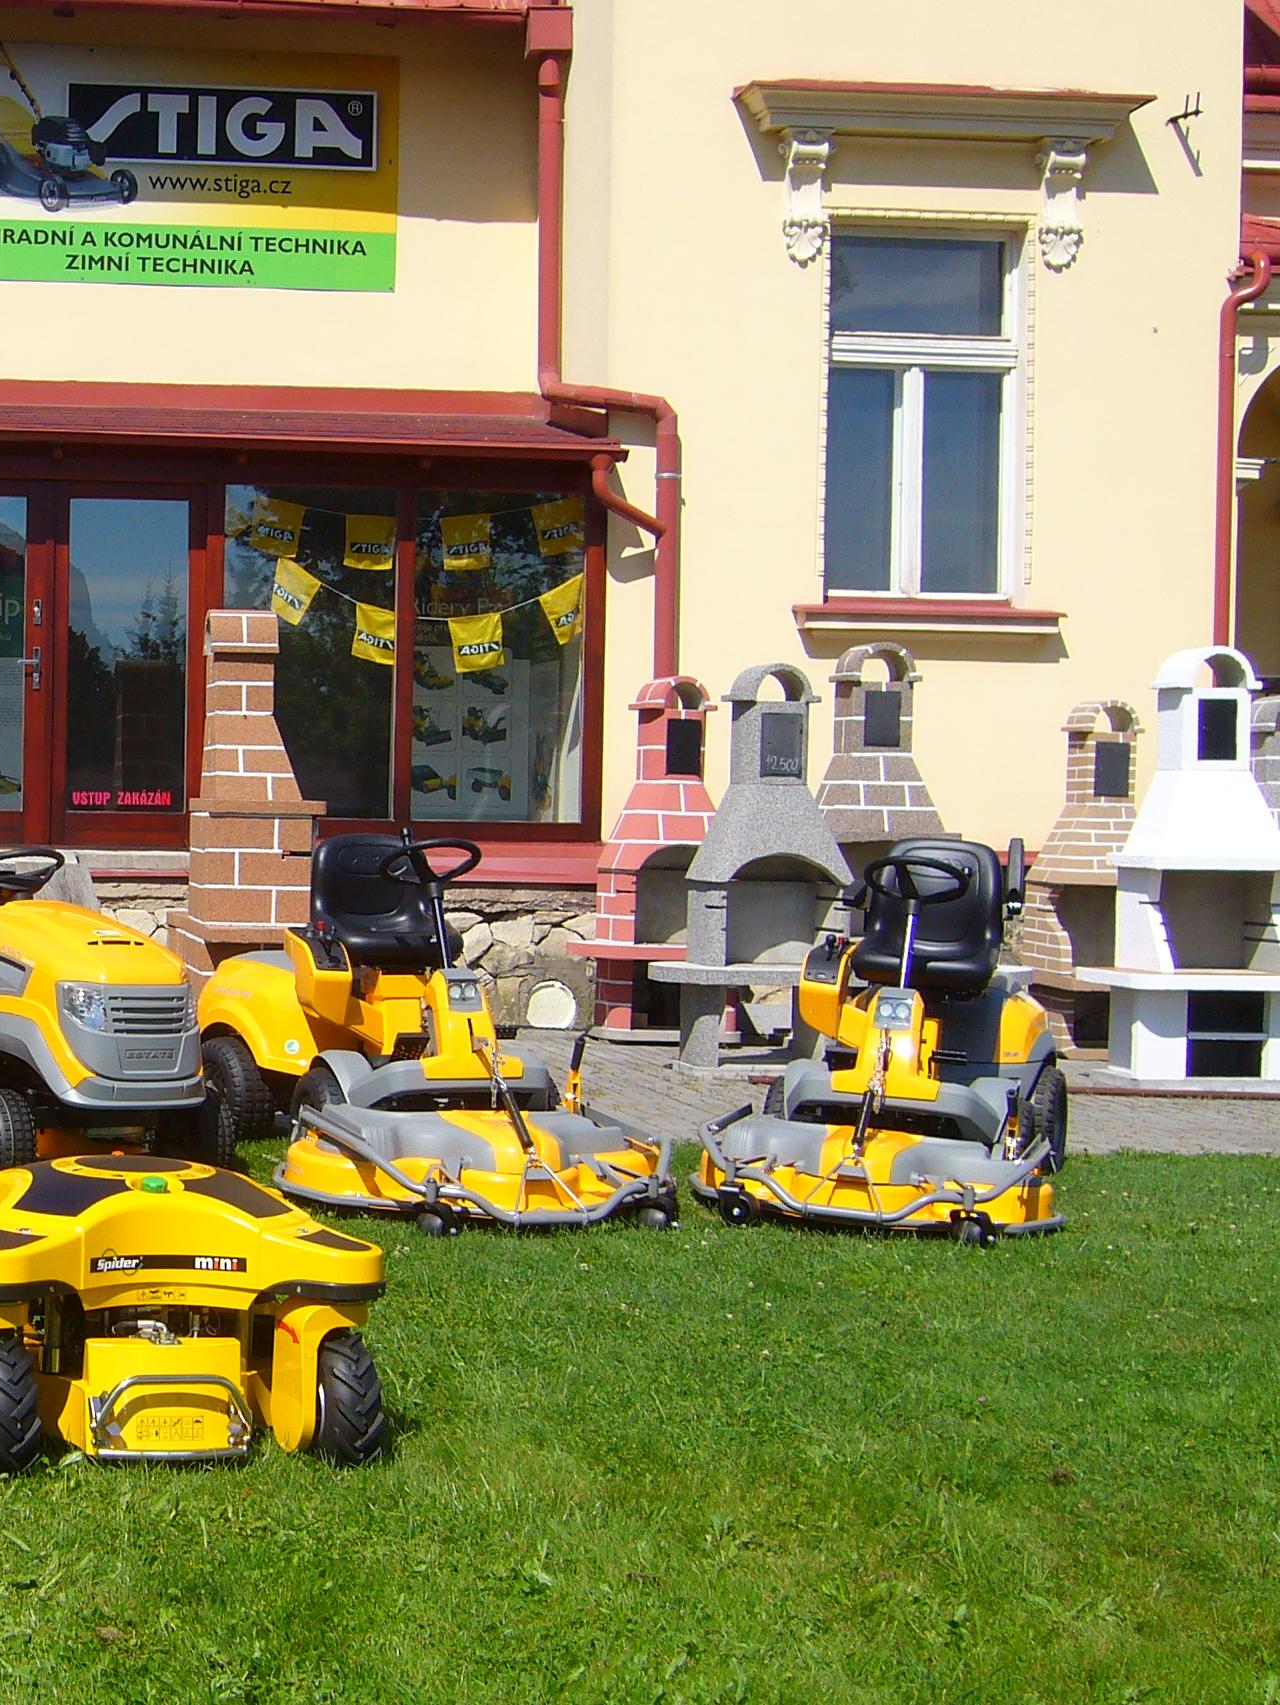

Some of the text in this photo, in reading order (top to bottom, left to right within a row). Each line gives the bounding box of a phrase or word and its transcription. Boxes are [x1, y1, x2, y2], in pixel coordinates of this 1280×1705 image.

[148, 173, 292, 198] www.stiga.cz
[80, 229, 97, 248] A
[103, 229, 244, 253] KOMUNÁLNÍ
[249, 236, 367, 257] TECHNIKA
[65, 251, 255, 276] ZIMNÍ TECHNIKA
[72, 789, 171, 806] VSTUP ZAKÁZÁN
[96, 1256, 238, 1272] Spider mini
